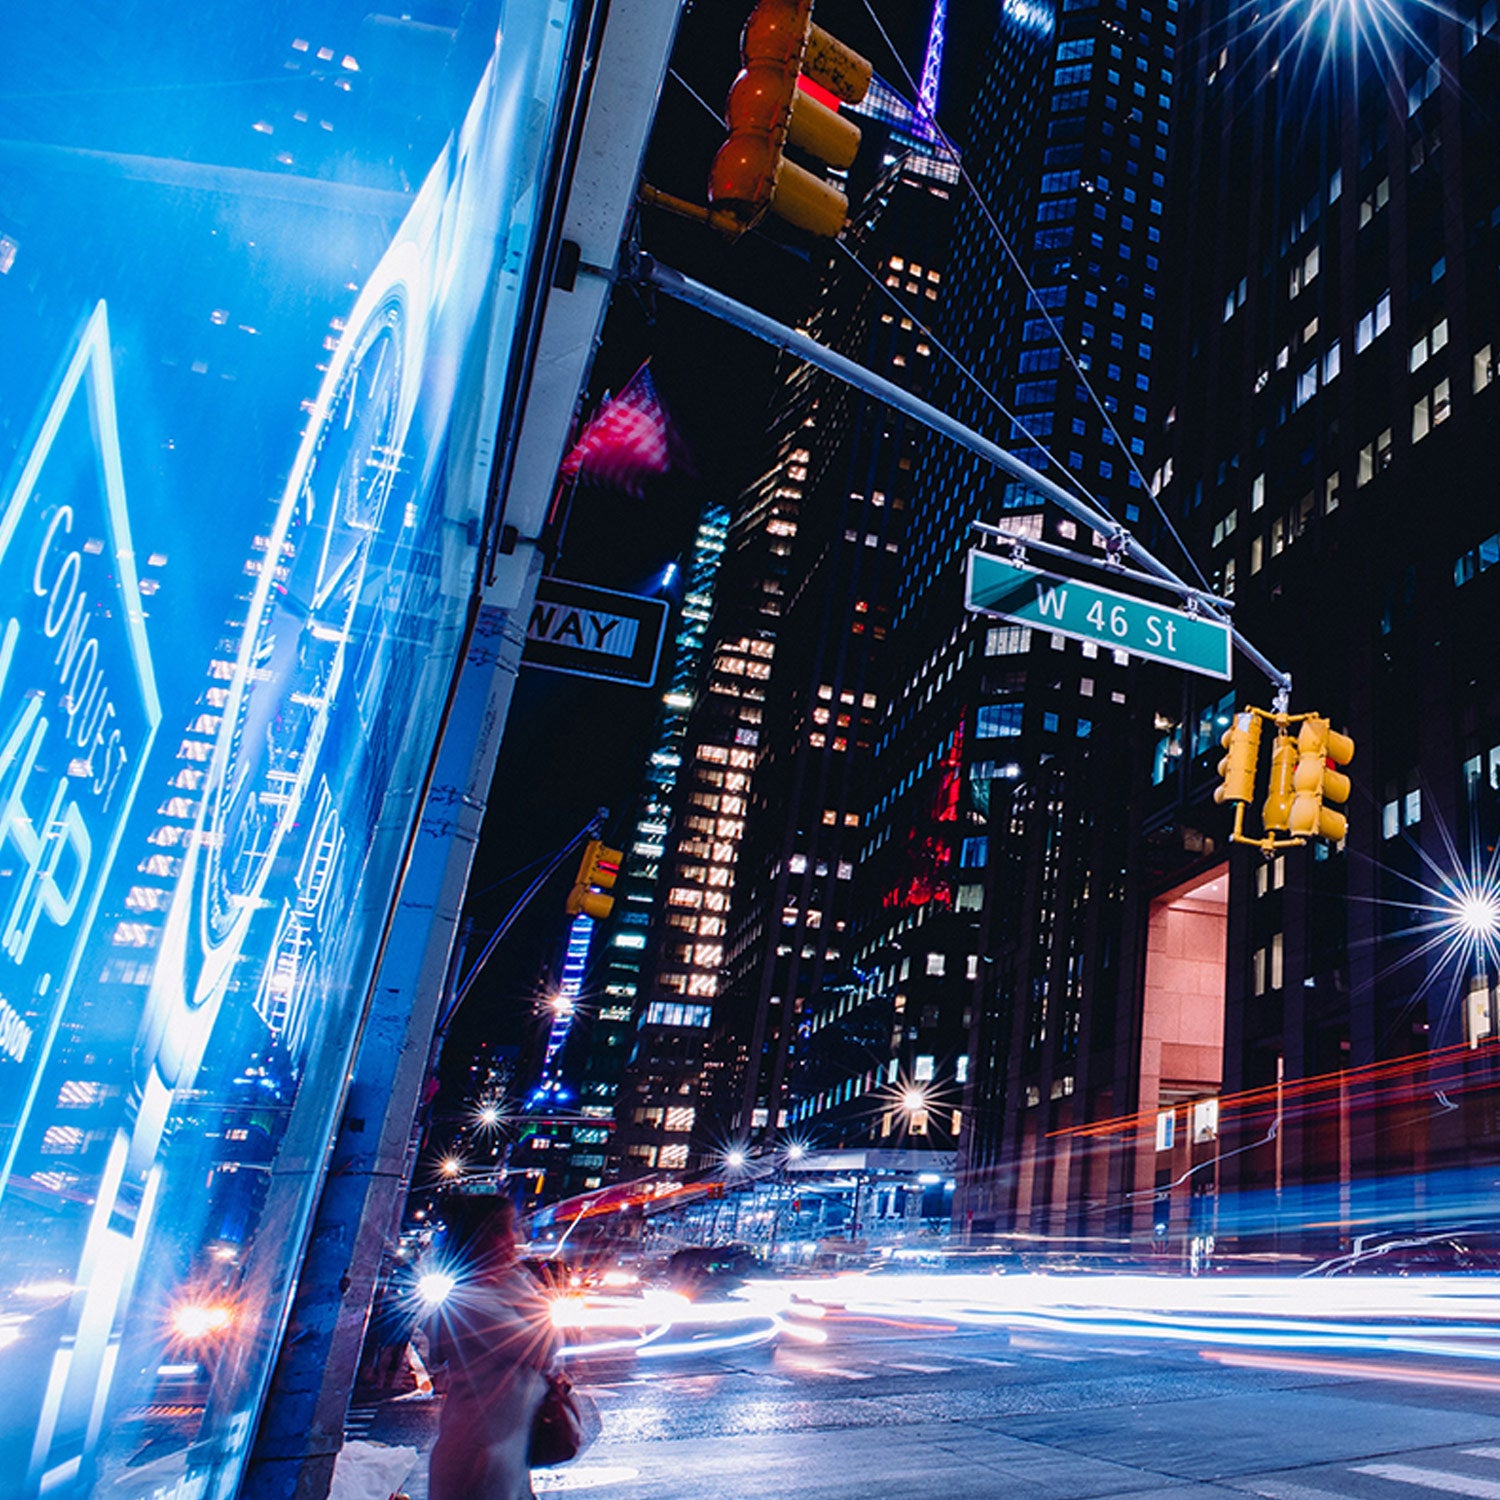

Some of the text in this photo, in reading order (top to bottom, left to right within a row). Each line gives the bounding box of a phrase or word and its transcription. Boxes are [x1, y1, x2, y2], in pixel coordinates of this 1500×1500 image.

[33, 504, 128, 814] CONQUEST
[1036, 582, 1177, 652] W 46 St
